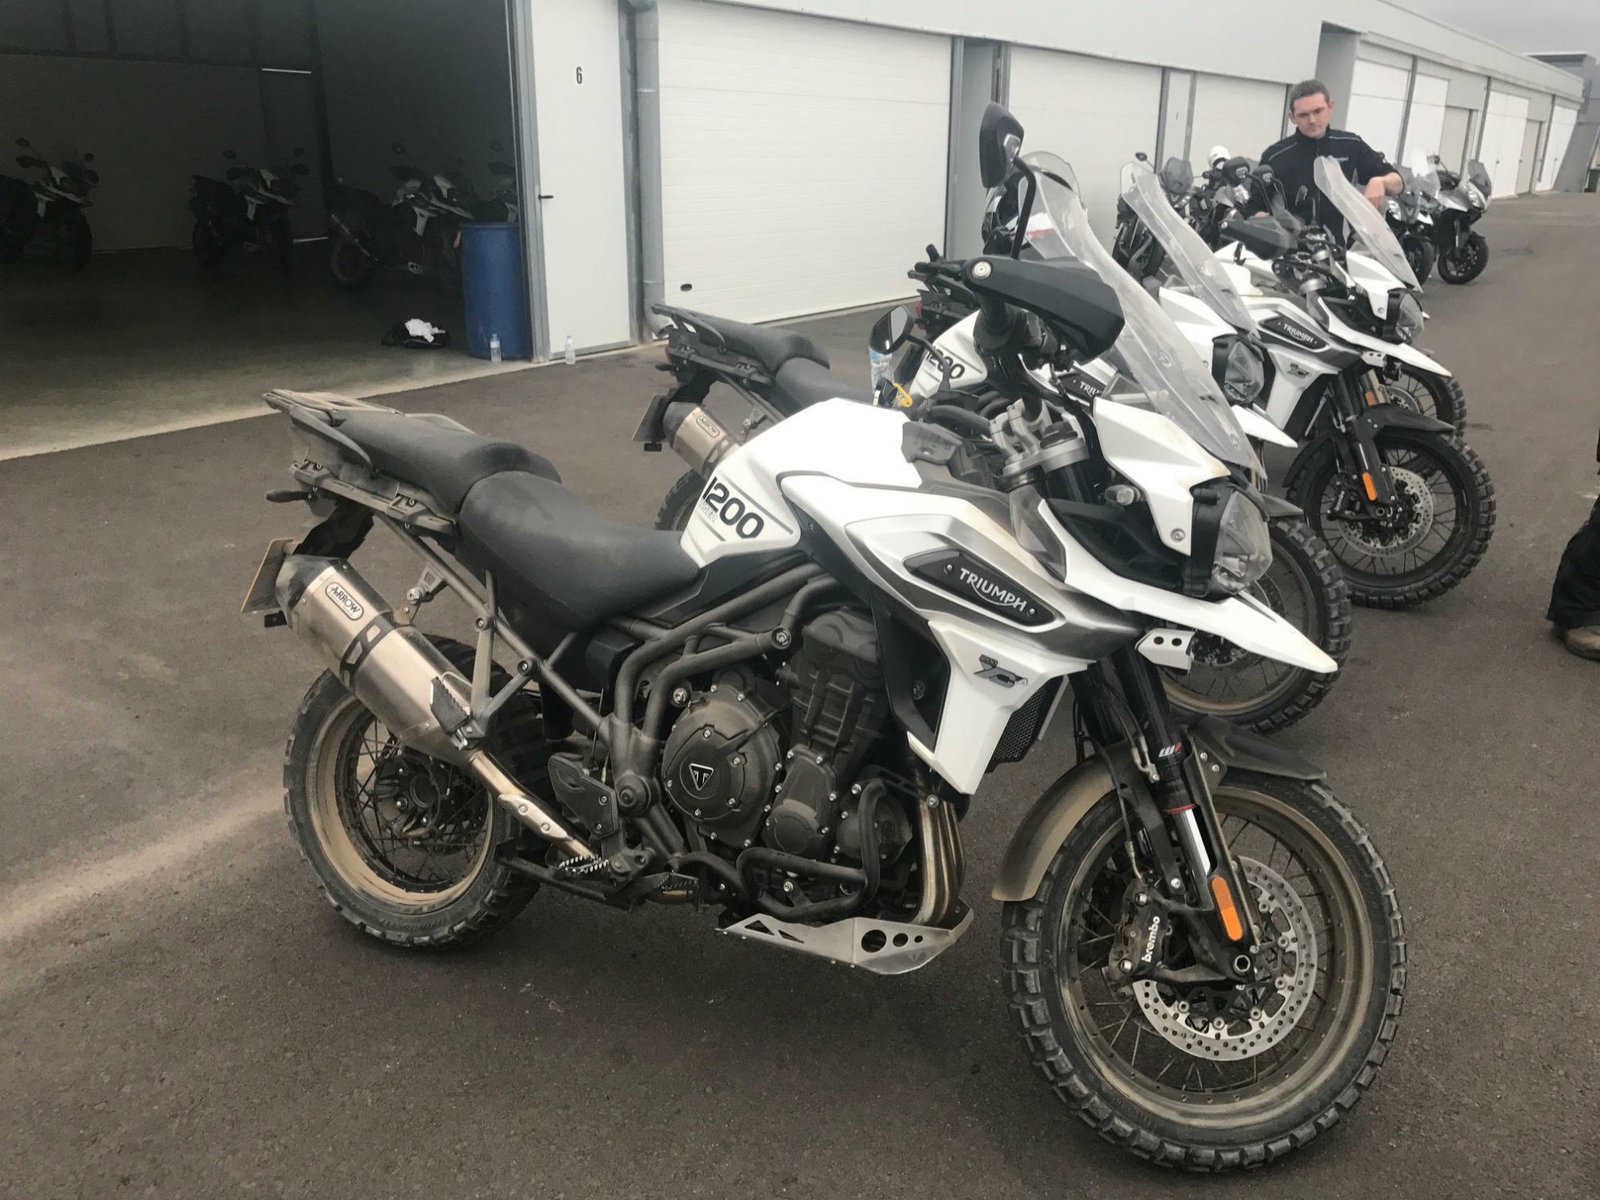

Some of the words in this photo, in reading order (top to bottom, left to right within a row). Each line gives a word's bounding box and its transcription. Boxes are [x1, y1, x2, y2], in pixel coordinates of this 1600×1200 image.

[576, 66, 583, 85] 6
[1283, 323, 1314, 344] TRIUMPH
[702, 476, 764, 539] 1200
[330, 586, 361, 613] ARROW
[960, 567, 1027, 612] TRIUMPH
[1141, 915, 1160, 963] brembo
